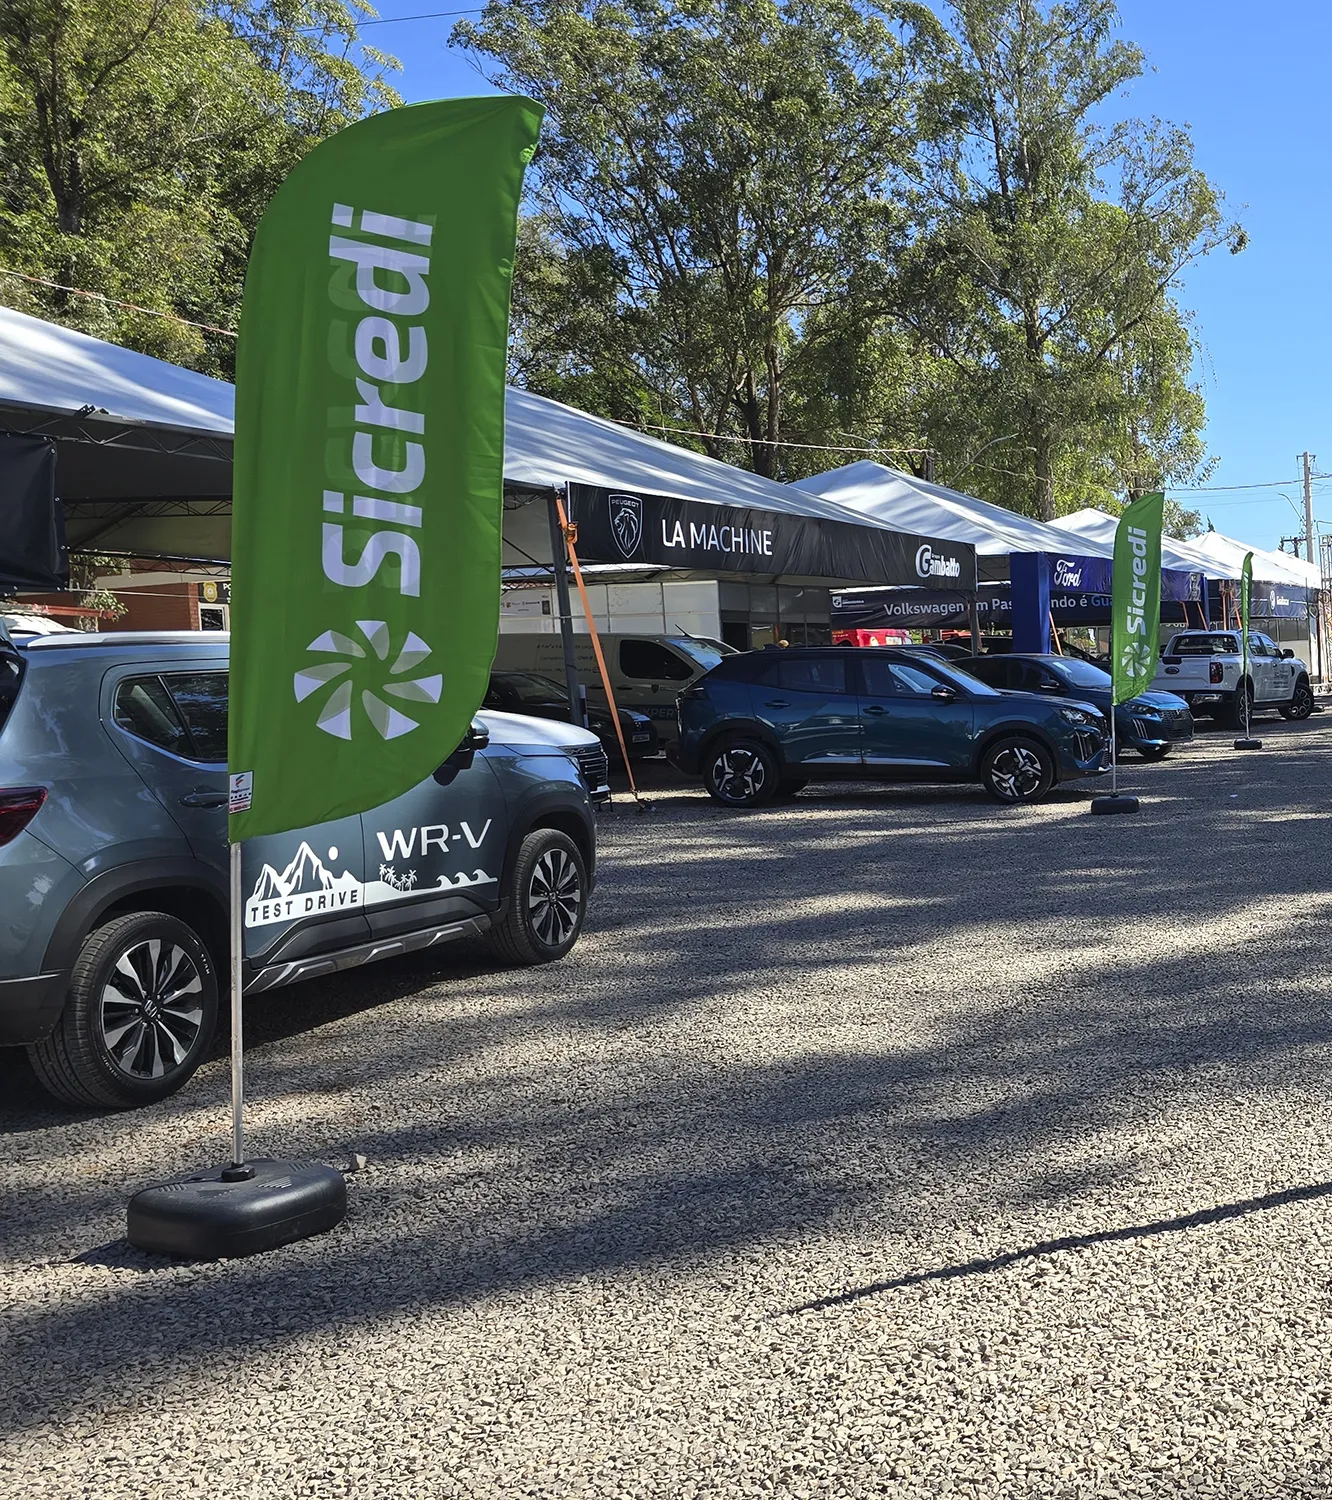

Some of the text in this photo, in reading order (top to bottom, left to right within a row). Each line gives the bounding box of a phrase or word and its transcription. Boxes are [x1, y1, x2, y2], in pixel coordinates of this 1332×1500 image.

[321, 202, 437, 598] Sicredi
[611, 499, 640, 508] PEUGEOT
[662, 519, 773, 556] LA MACHINE
[916, 544, 960, 578] Gambatto
[1054, 559, 1082, 587] Ford
[1127, 526, 1147, 636] Sicredi
[884, 602, 965, 616] Volkswagen
[992, 598, 1012, 610] Pas
[1051, 596, 1076, 608] ndo
[1081, 596, 1088, 608] é
[1091, 596, 1113, 608] Gua
[376, 819, 492, 861] WR-V
[251, 890, 358, 922] TEST DRIVE
